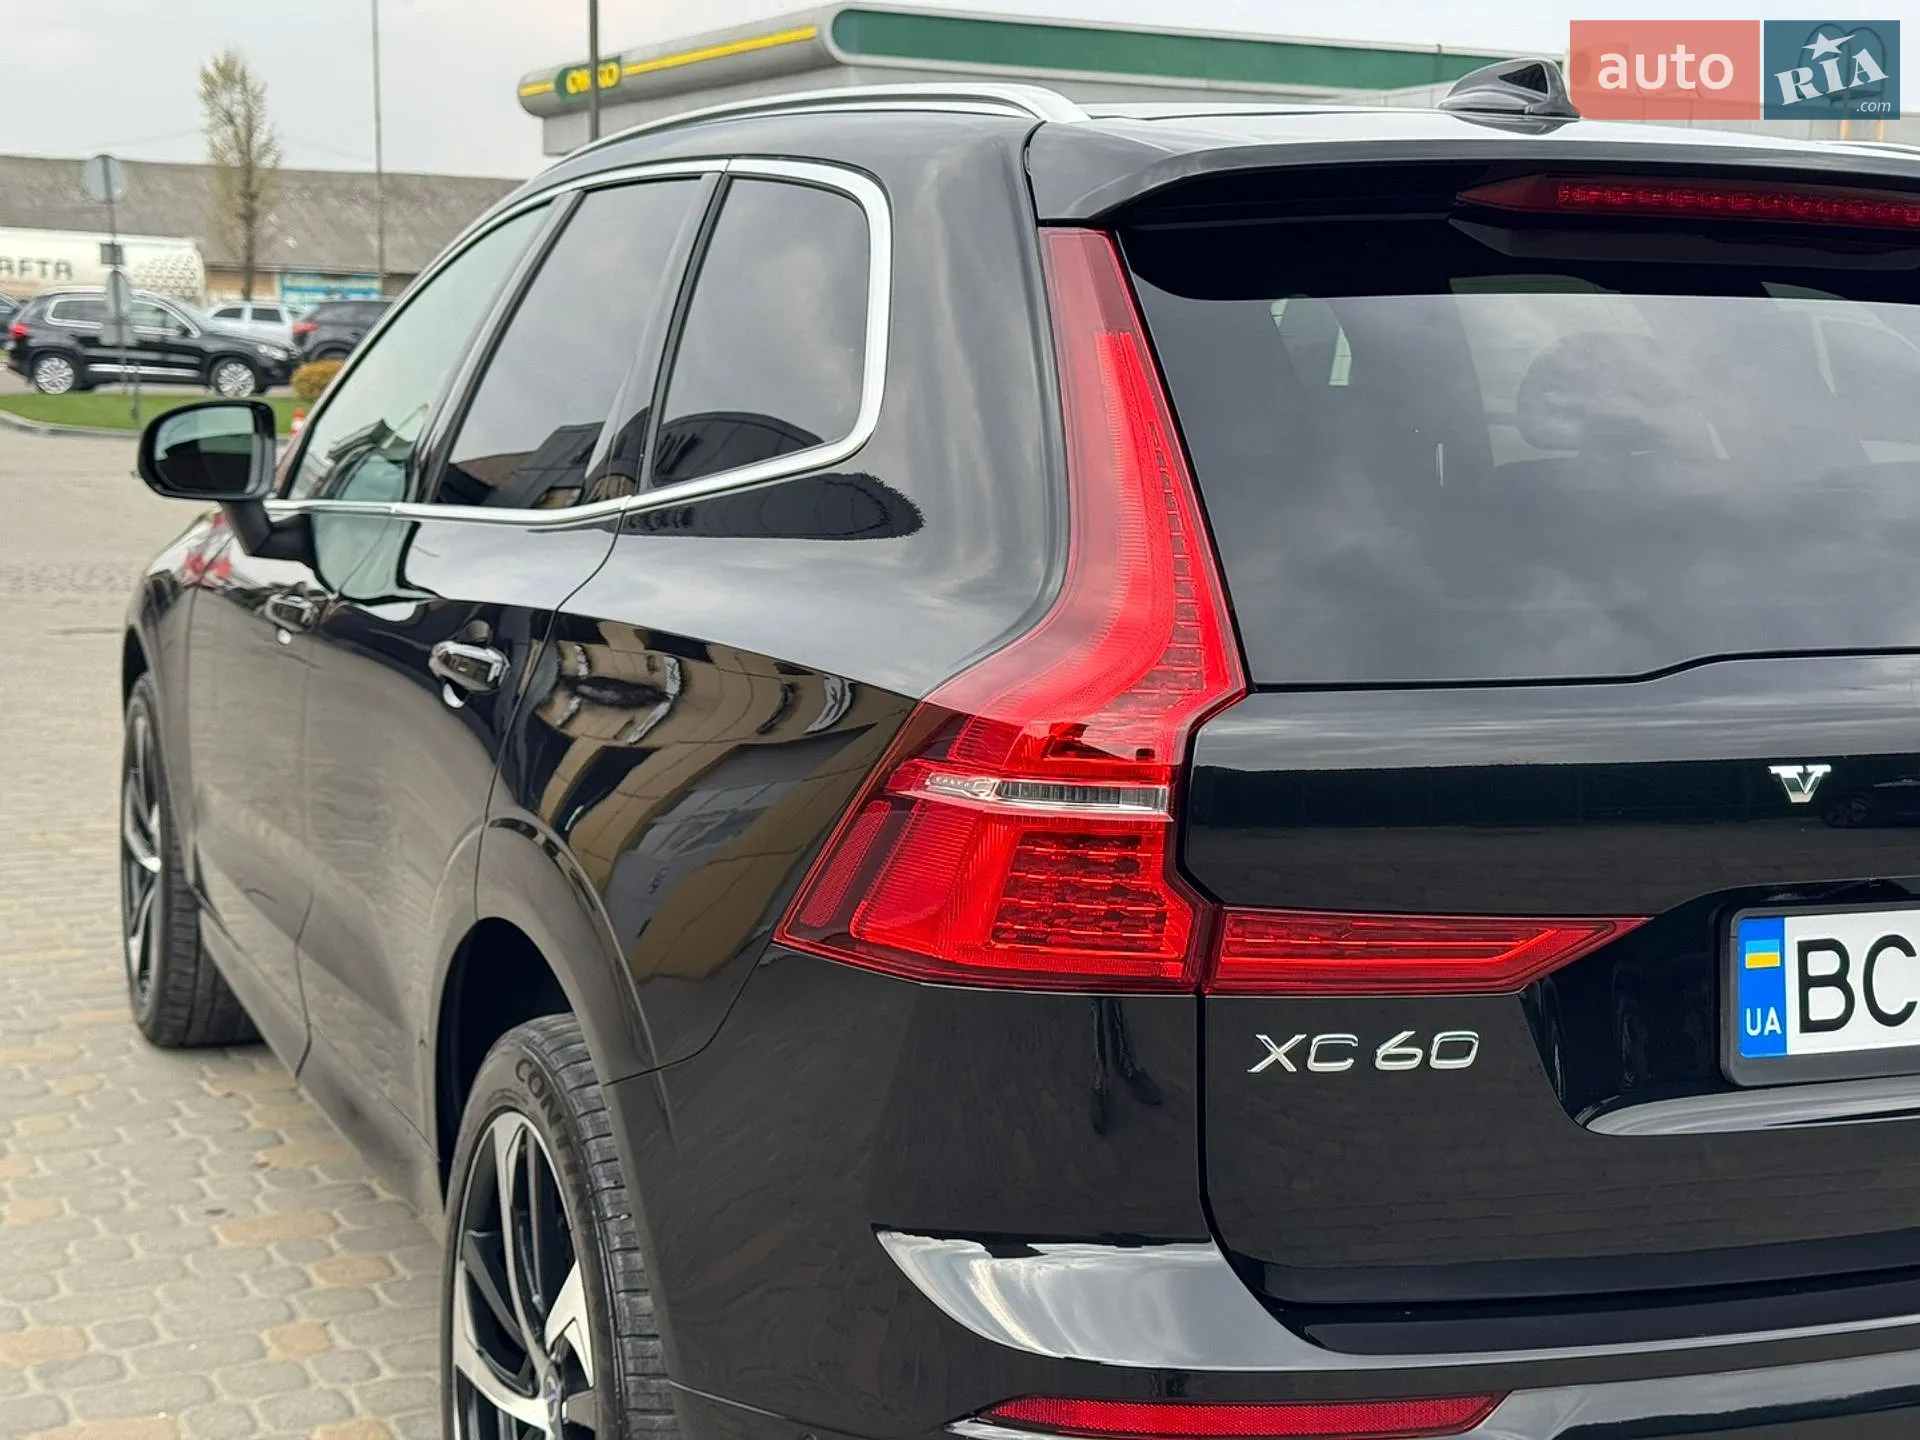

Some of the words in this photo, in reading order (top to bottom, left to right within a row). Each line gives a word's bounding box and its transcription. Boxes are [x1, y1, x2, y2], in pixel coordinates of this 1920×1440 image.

[1797, 934, 1919, 1034] BC
[1745, 1007, 1782, 1037] UA
[1247, 1033, 1358, 1073] XC
[1374, 1030, 1479, 1071] 60
